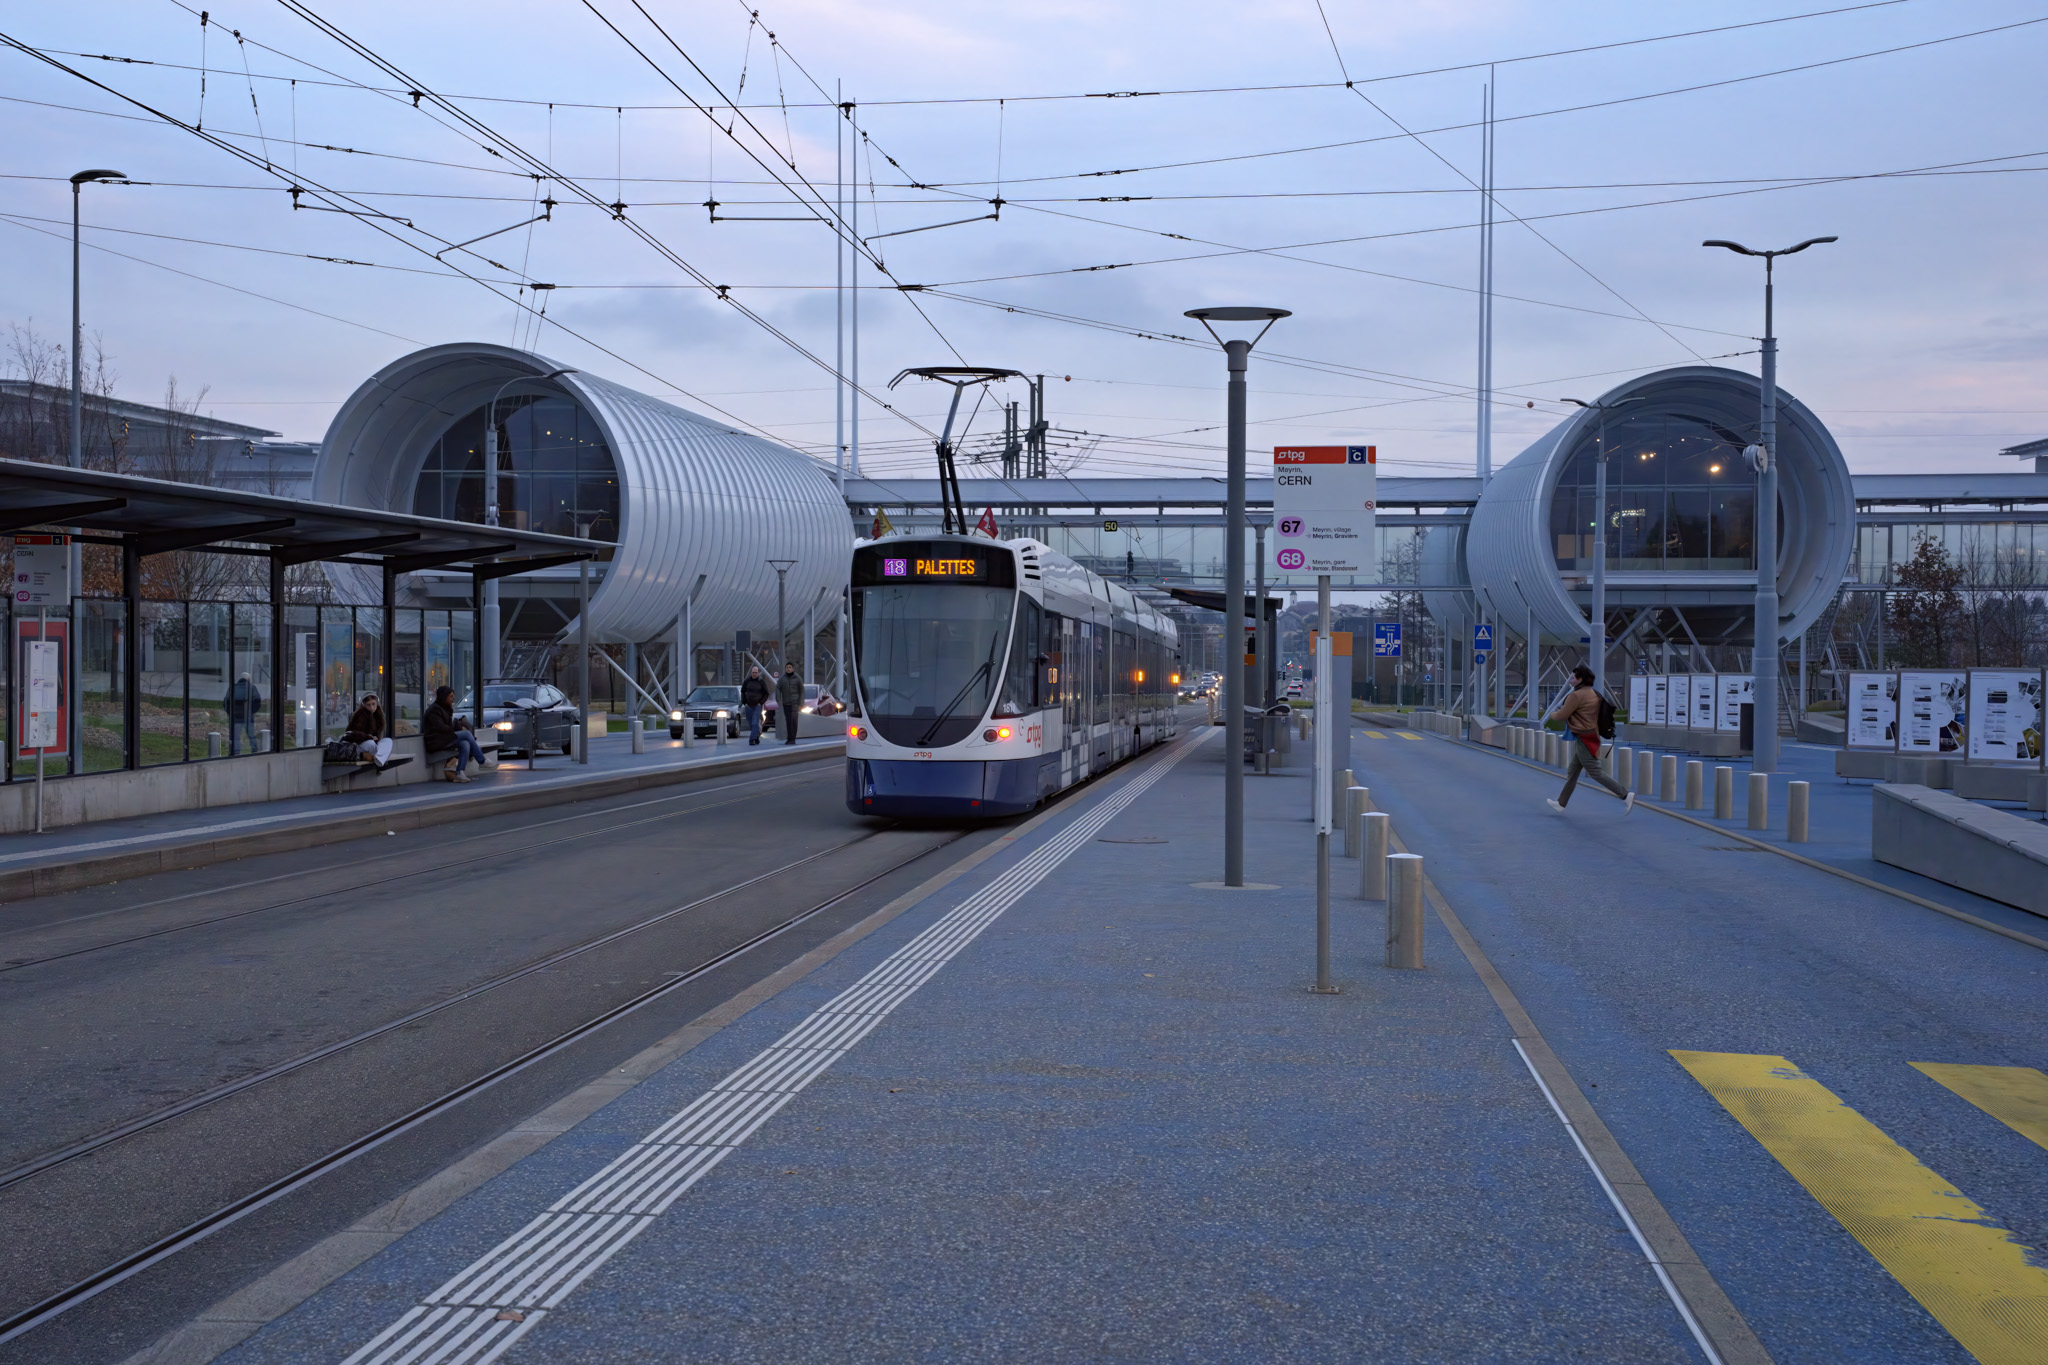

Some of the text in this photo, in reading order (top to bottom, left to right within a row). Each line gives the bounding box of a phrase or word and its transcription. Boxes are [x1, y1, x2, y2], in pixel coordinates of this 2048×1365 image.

[1352, 452, 1361, 461] C
[1277, 466, 1303, 474] Meyrin,
[1277, 475, 1312, 486] CERN
[1105, 521, 1117, 531] 50
[1281, 520, 1301, 533] 67
[1280, 552, 1302, 566] 68
[887, 559, 975, 575] 18 PALETTES
[18, 574, 28, 582] 67
